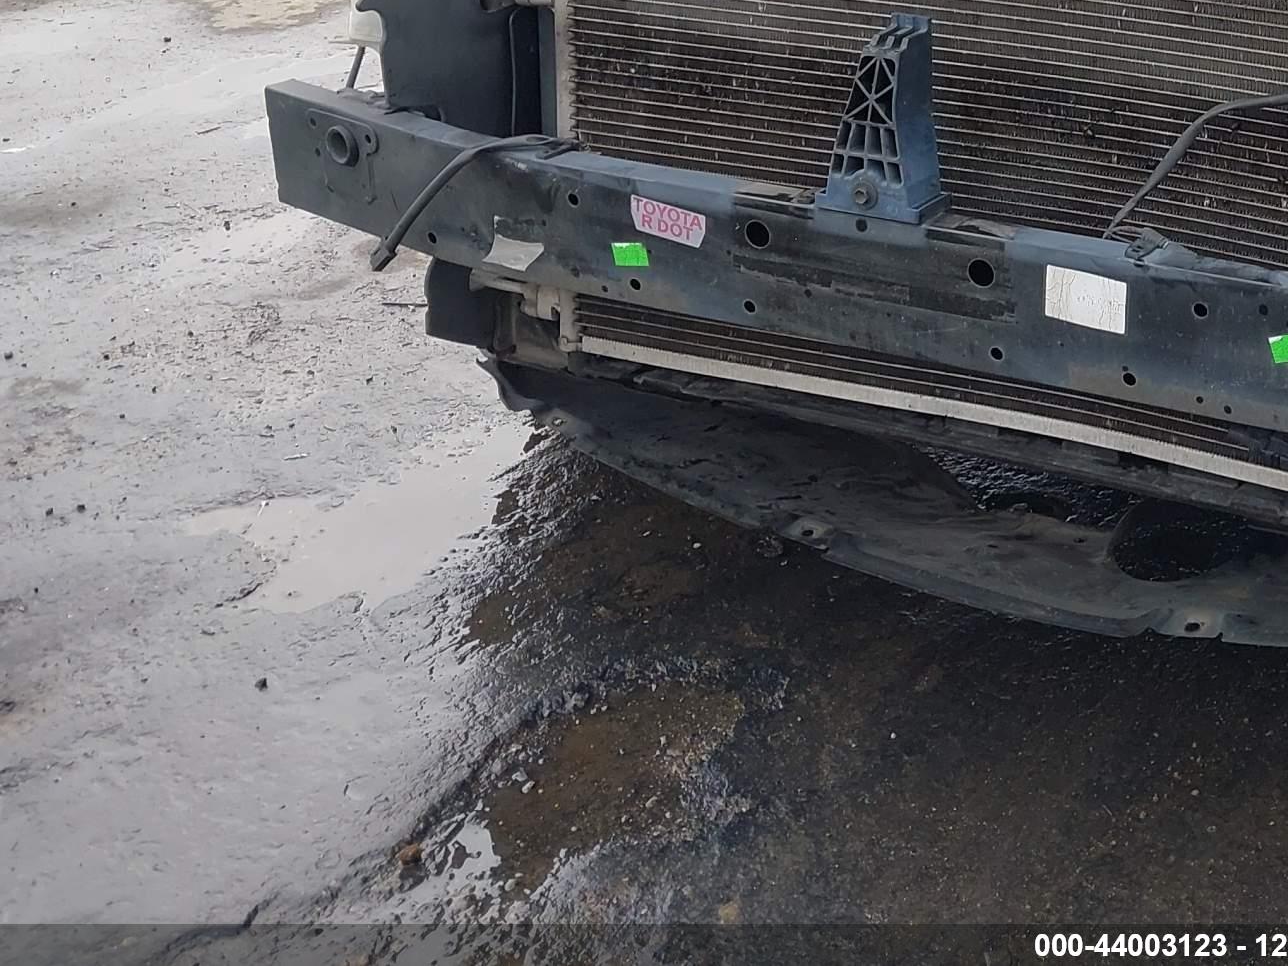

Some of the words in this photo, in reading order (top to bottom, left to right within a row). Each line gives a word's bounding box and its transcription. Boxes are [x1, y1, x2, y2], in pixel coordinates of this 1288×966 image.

[633, 198, 702, 230] TOYOTA
[642, 215, 652, 229] R
[658, 219, 693, 240] DOT
